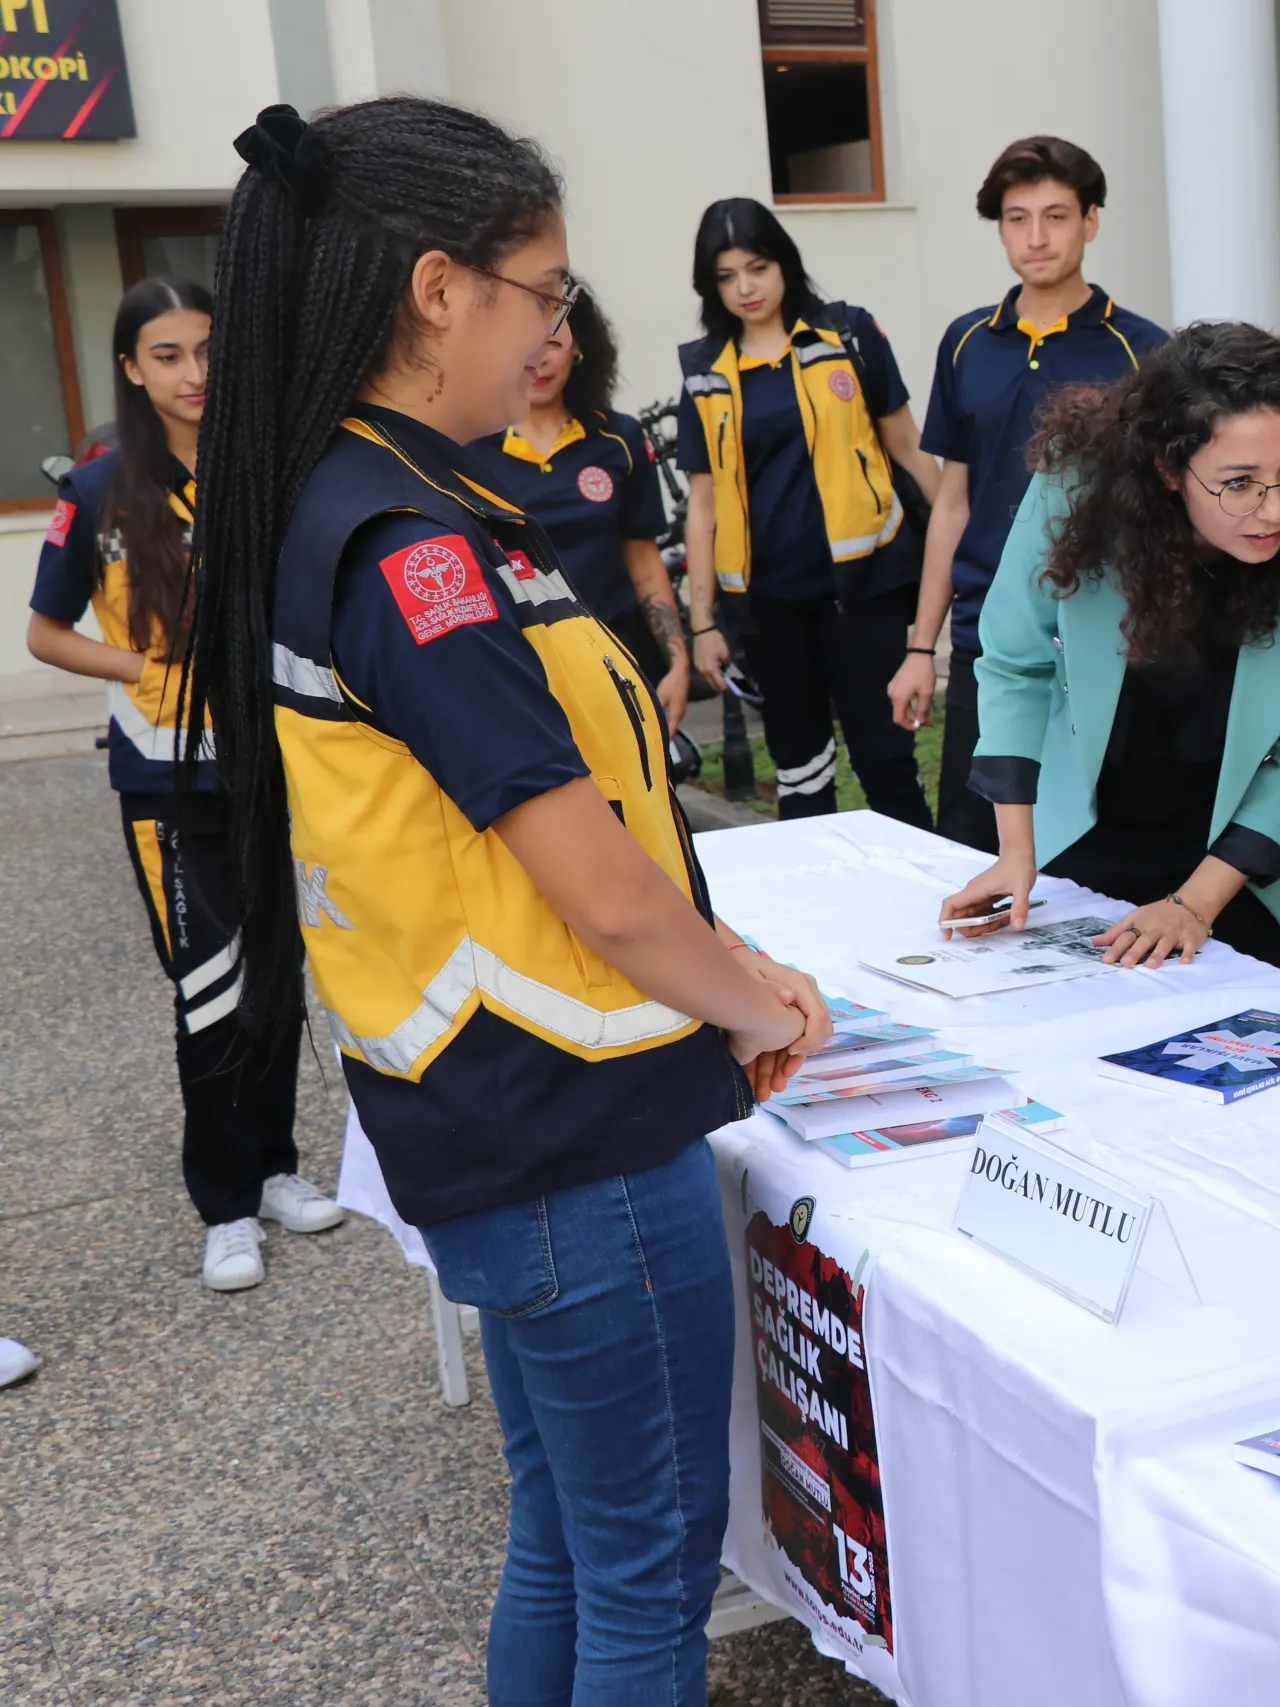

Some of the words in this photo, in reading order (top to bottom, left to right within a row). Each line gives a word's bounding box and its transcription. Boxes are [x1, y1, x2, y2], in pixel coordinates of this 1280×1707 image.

[417, 623, 446, 640] GENEL
[969, 1147, 1049, 1204] DOĞAN
[1049, 1182, 1137, 1243] MUTLU
[749, 1244, 864, 1370] DEPREMDE
[753, 1296, 823, 1384] SAĞLIK
[757, 1338, 849, 1451] ÇALIŞANI
[833, 1522, 872, 1597] 13
